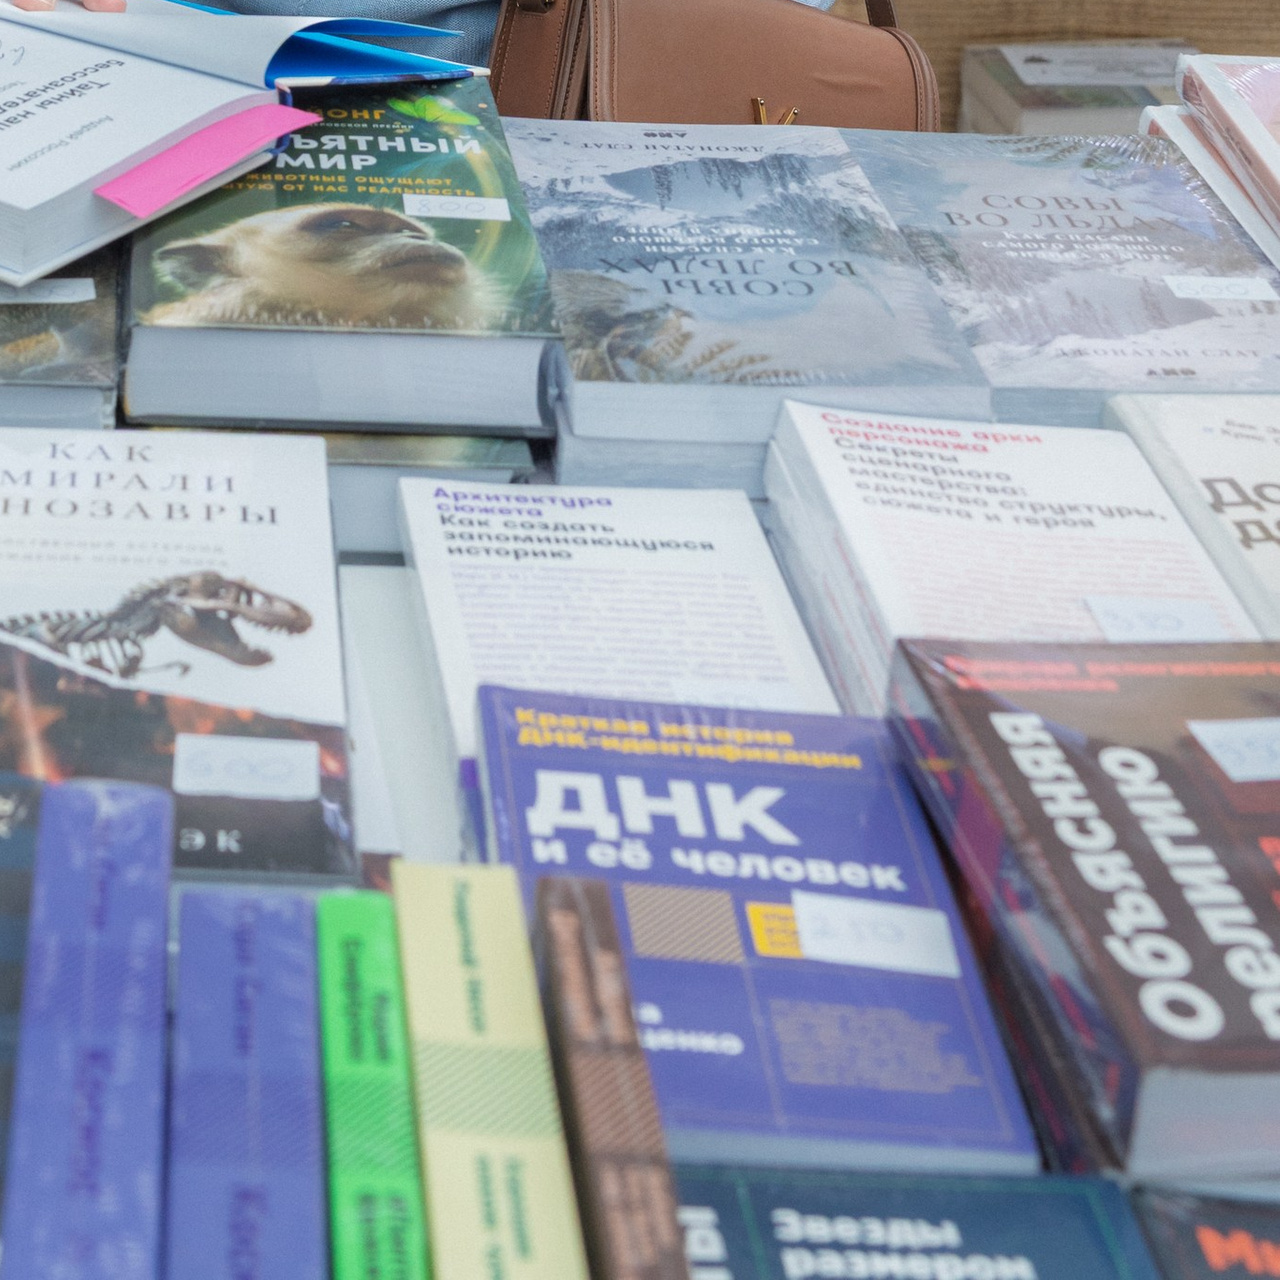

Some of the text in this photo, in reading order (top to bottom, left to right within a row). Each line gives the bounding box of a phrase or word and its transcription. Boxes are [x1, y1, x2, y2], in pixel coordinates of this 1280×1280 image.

[35, 79, 111, 110] Тайны
[288, 133, 482, 155] ЪЯТНЫЙ
[275, 152, 378, 171] МИР
[354, 174, 453, 186] ОЩУЩАЮТ
[357, 184, 476, 196] РЕАЛЬНОСТЬ
[981, 194, 1125, 212] СОВЫ
[942, 211, 1010, 227] ВО
[600, 255, 858, 277] ВО ЛЬДАХ
[660, 277, 815, 297] СОВЫ
[821, 412, 1044, 444] Создание арки
[828, 425, 990, 454] персонажа
[48, 441, 154, 463] КАК
[833, 435, 959, 464] Секреты
[841, 451, 1013, 483] сценарного
[432, 486, 614, 510] Архитектура
[854, 479, 990, 509] единство
[436, 502, 544, 518] сюжета
[439, 513, 616, 534] Как создать
[442, 529, 716, 553] запоминающуюся
[447, 544, 573, 561] историю
[515, 706, 795, 747] Краткая история
[526, 768, 803, 846] ДНК
[531, 839, 569, 865] и
[669, 846, 910, 892] человек
[770, 1207, 963, 1248] Звезды
